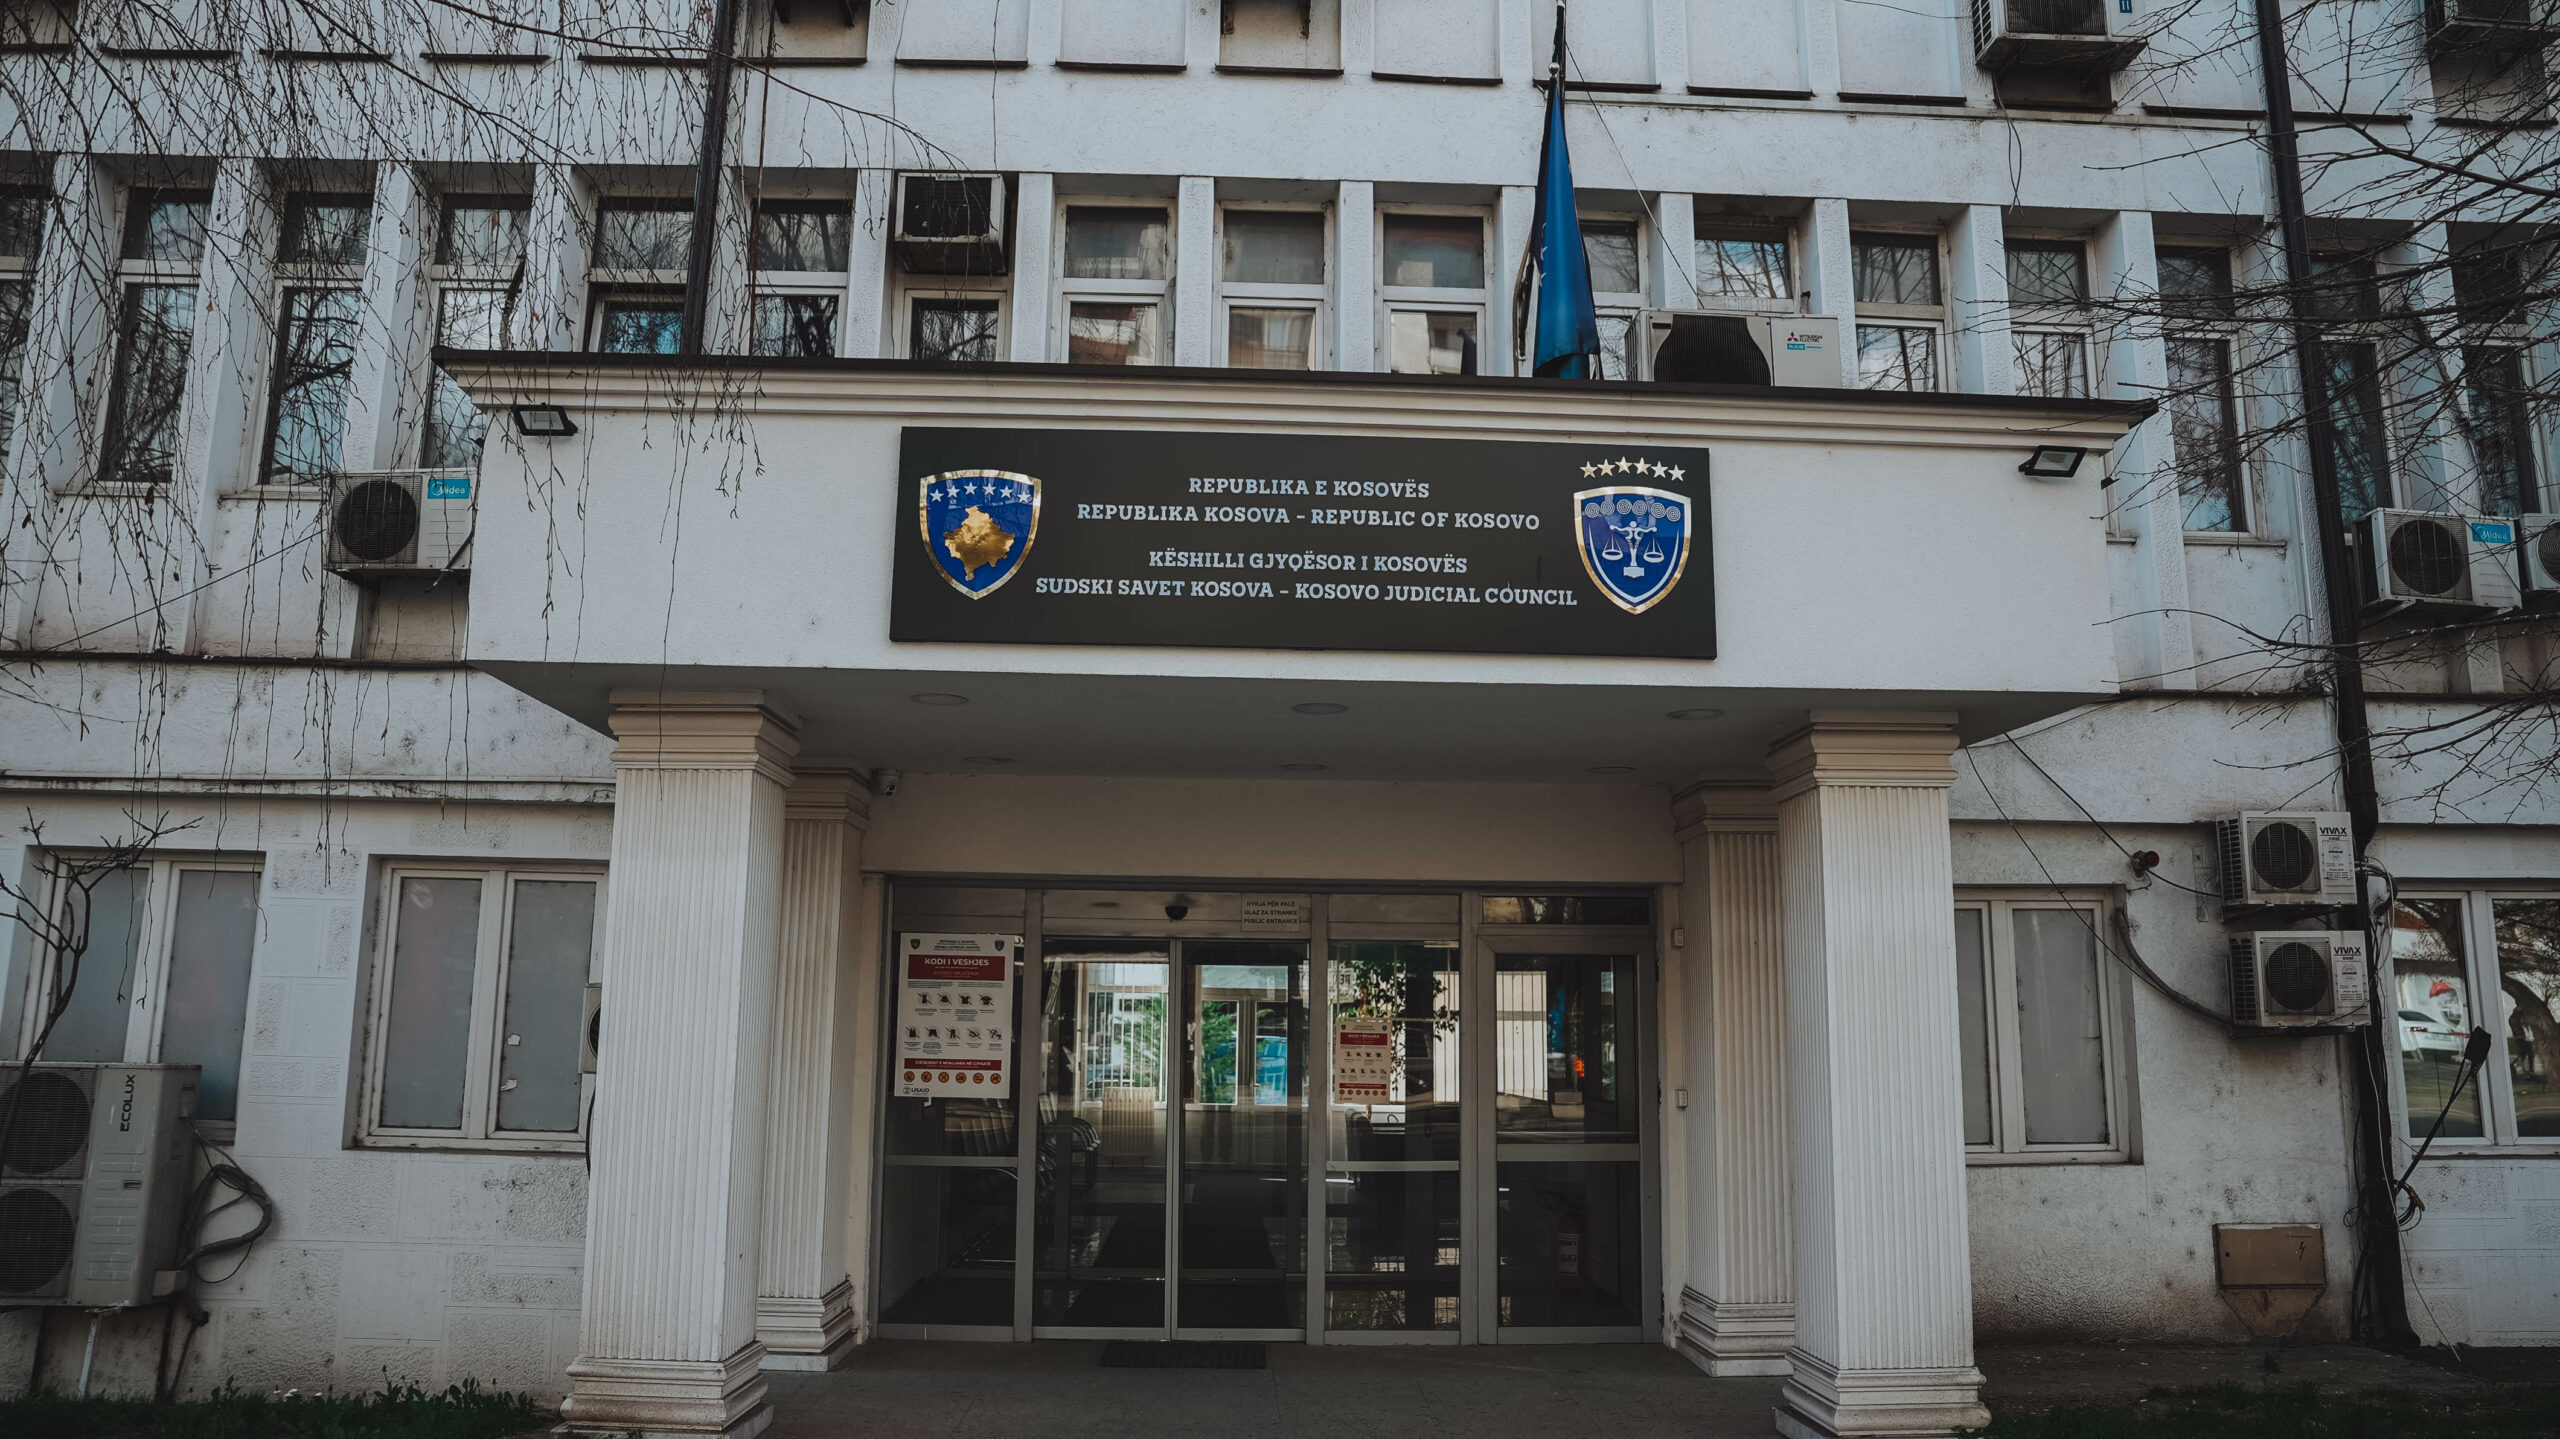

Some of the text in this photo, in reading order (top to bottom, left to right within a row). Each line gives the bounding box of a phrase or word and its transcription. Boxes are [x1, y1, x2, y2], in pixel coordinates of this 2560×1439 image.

[1188, 477, 1430, 499] REPUBLIKA E KOSOVËS
[1077, 503, 1200, 522] REPUBLIKA
[1203, 506, 1291, 524] KOSOVA
[1310, 508, 1416, 527] REPUBLIC
[1420, 511, 1449, 528] OF
[1454, 512, 1540, 531] KOSOVO
[1148, 547, 1468, 574] KËSHILLI GJYQËSOR I KOSOVËS
[1035, 577, 1114, 595] SUDSKI
[1117, 579, 1186, 597] SAVET
[1190, 580, 1275, 598] KOSOVA
[1295, 582, 1380, 601] KOSOVO
[1383, 585, 1481, 603] JUDICIAL
[1484, 587, 1578, 606] COUNCIL
[2319, 827, 2347, 835] VIVAX
[952, 958, 989, 966] VESHJES
[2333, 946, 2361, 954] VIVAX
[119, 1073, 136, 1132] ECOLUX
